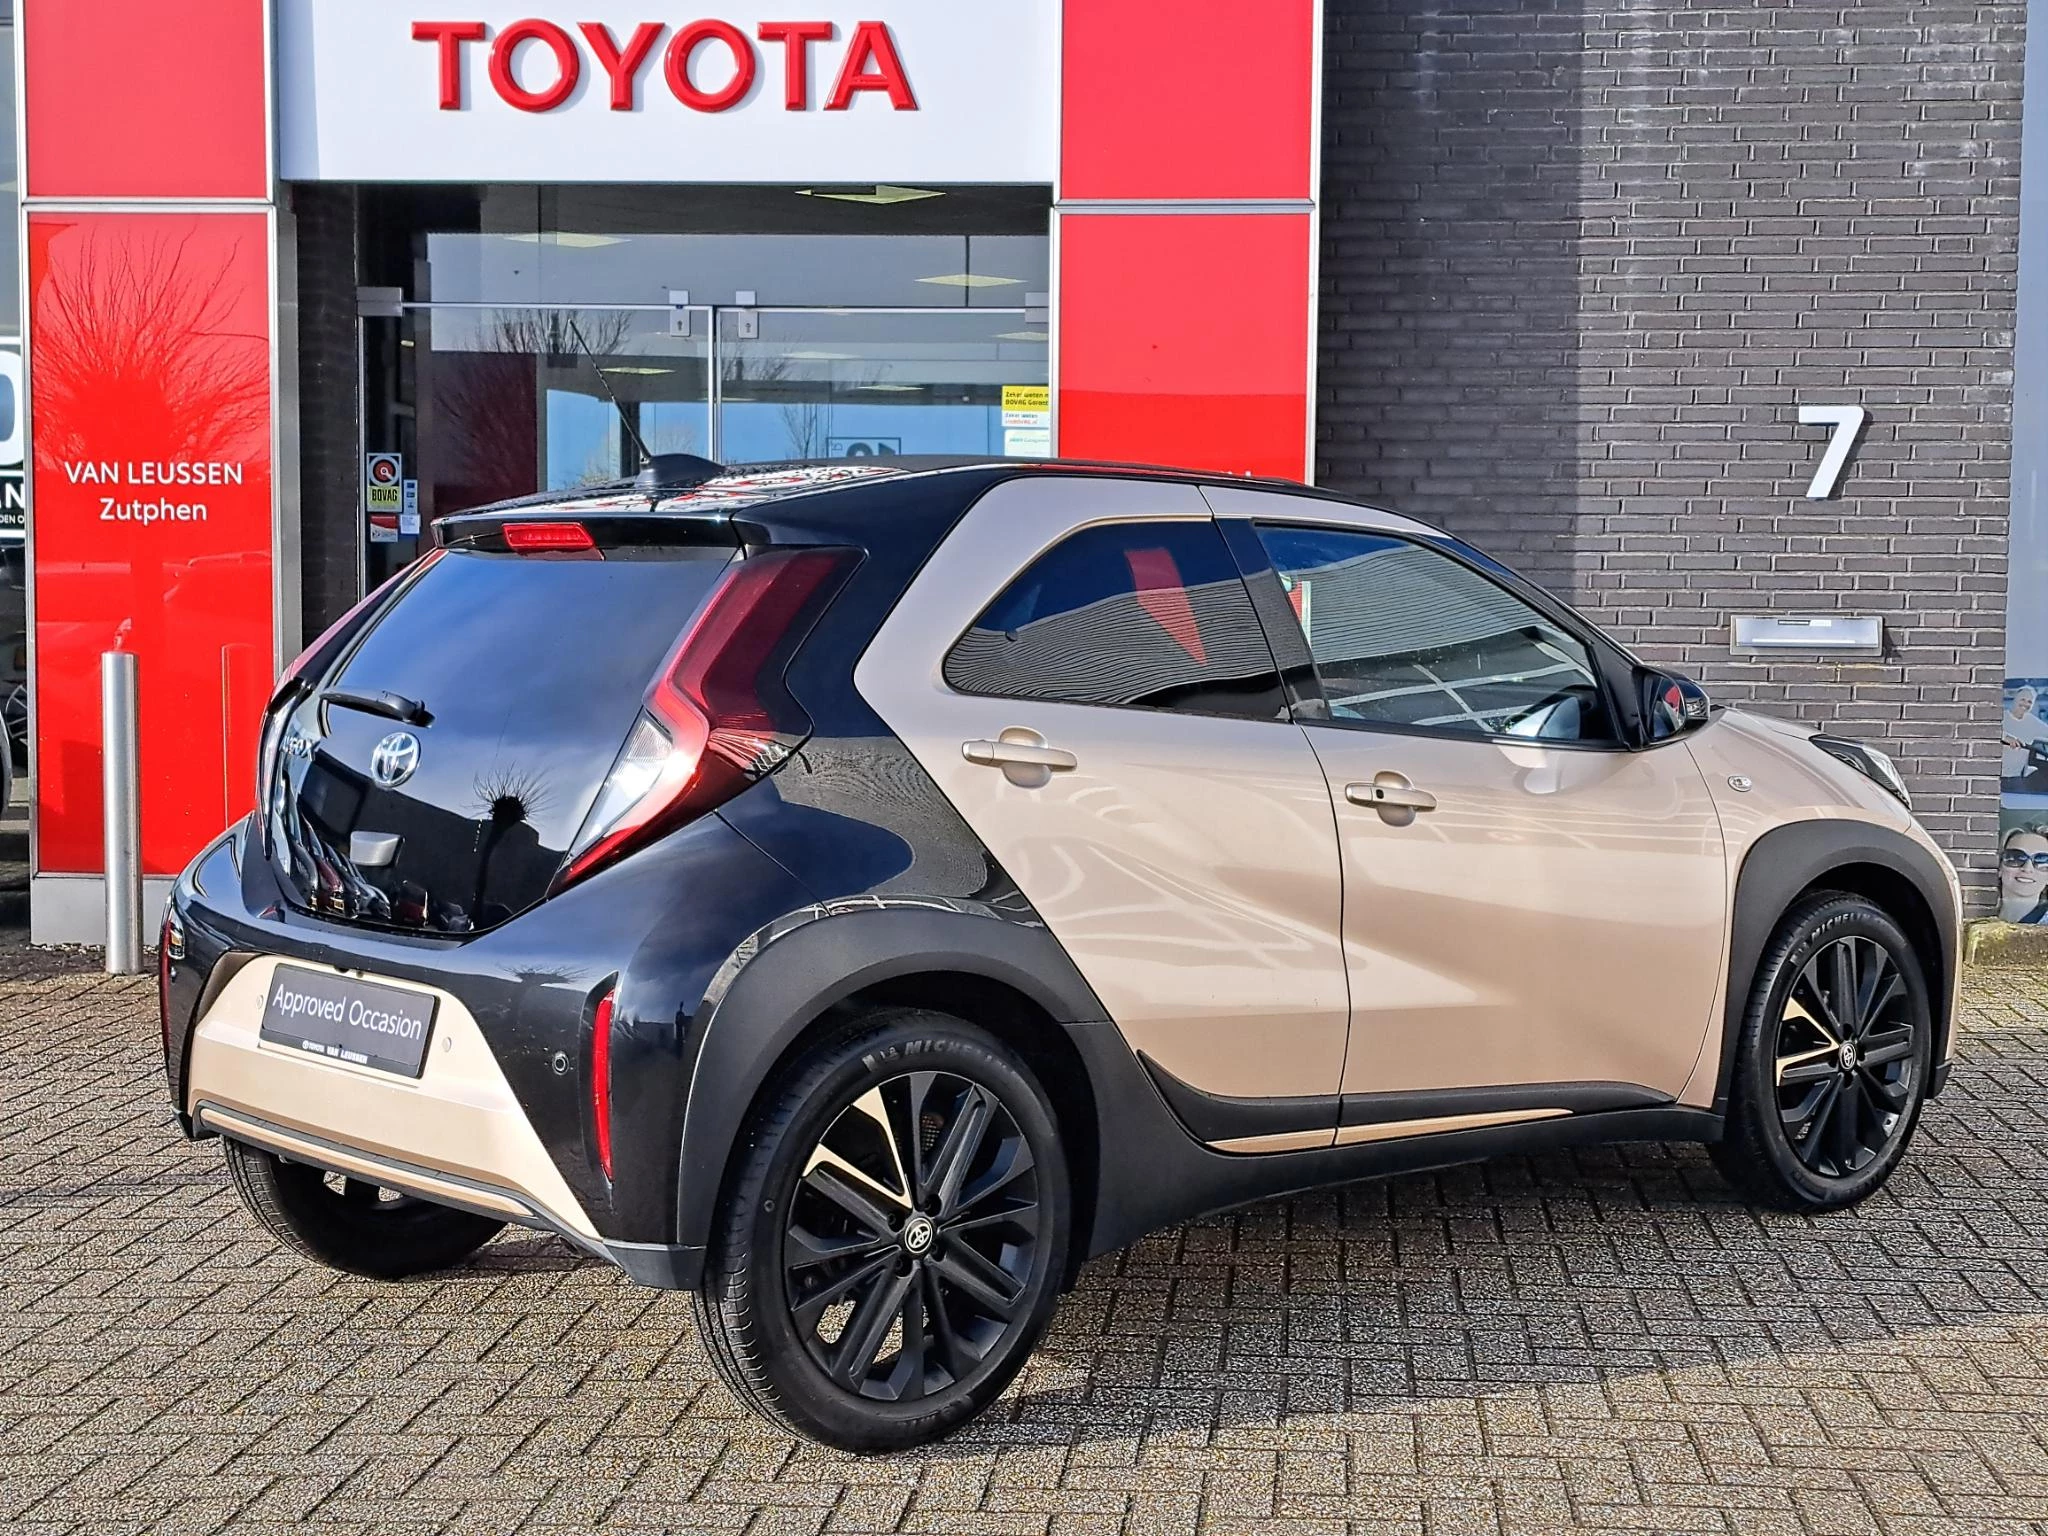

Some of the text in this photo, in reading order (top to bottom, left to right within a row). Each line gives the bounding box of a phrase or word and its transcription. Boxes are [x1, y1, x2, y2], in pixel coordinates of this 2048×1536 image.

[411, 18, 920, 113] TOYOTA
[1799, 406, 1864, 498] 7
[64, 461, 243, 485] VAN LEUSSEN
[371, 488, 398, 502] BOVAG
[99, 496, 208, 527] Zutphen
[272, 983, 422, 1041] Approved Occasion
[326, 1045, 340, 1057] VAN
